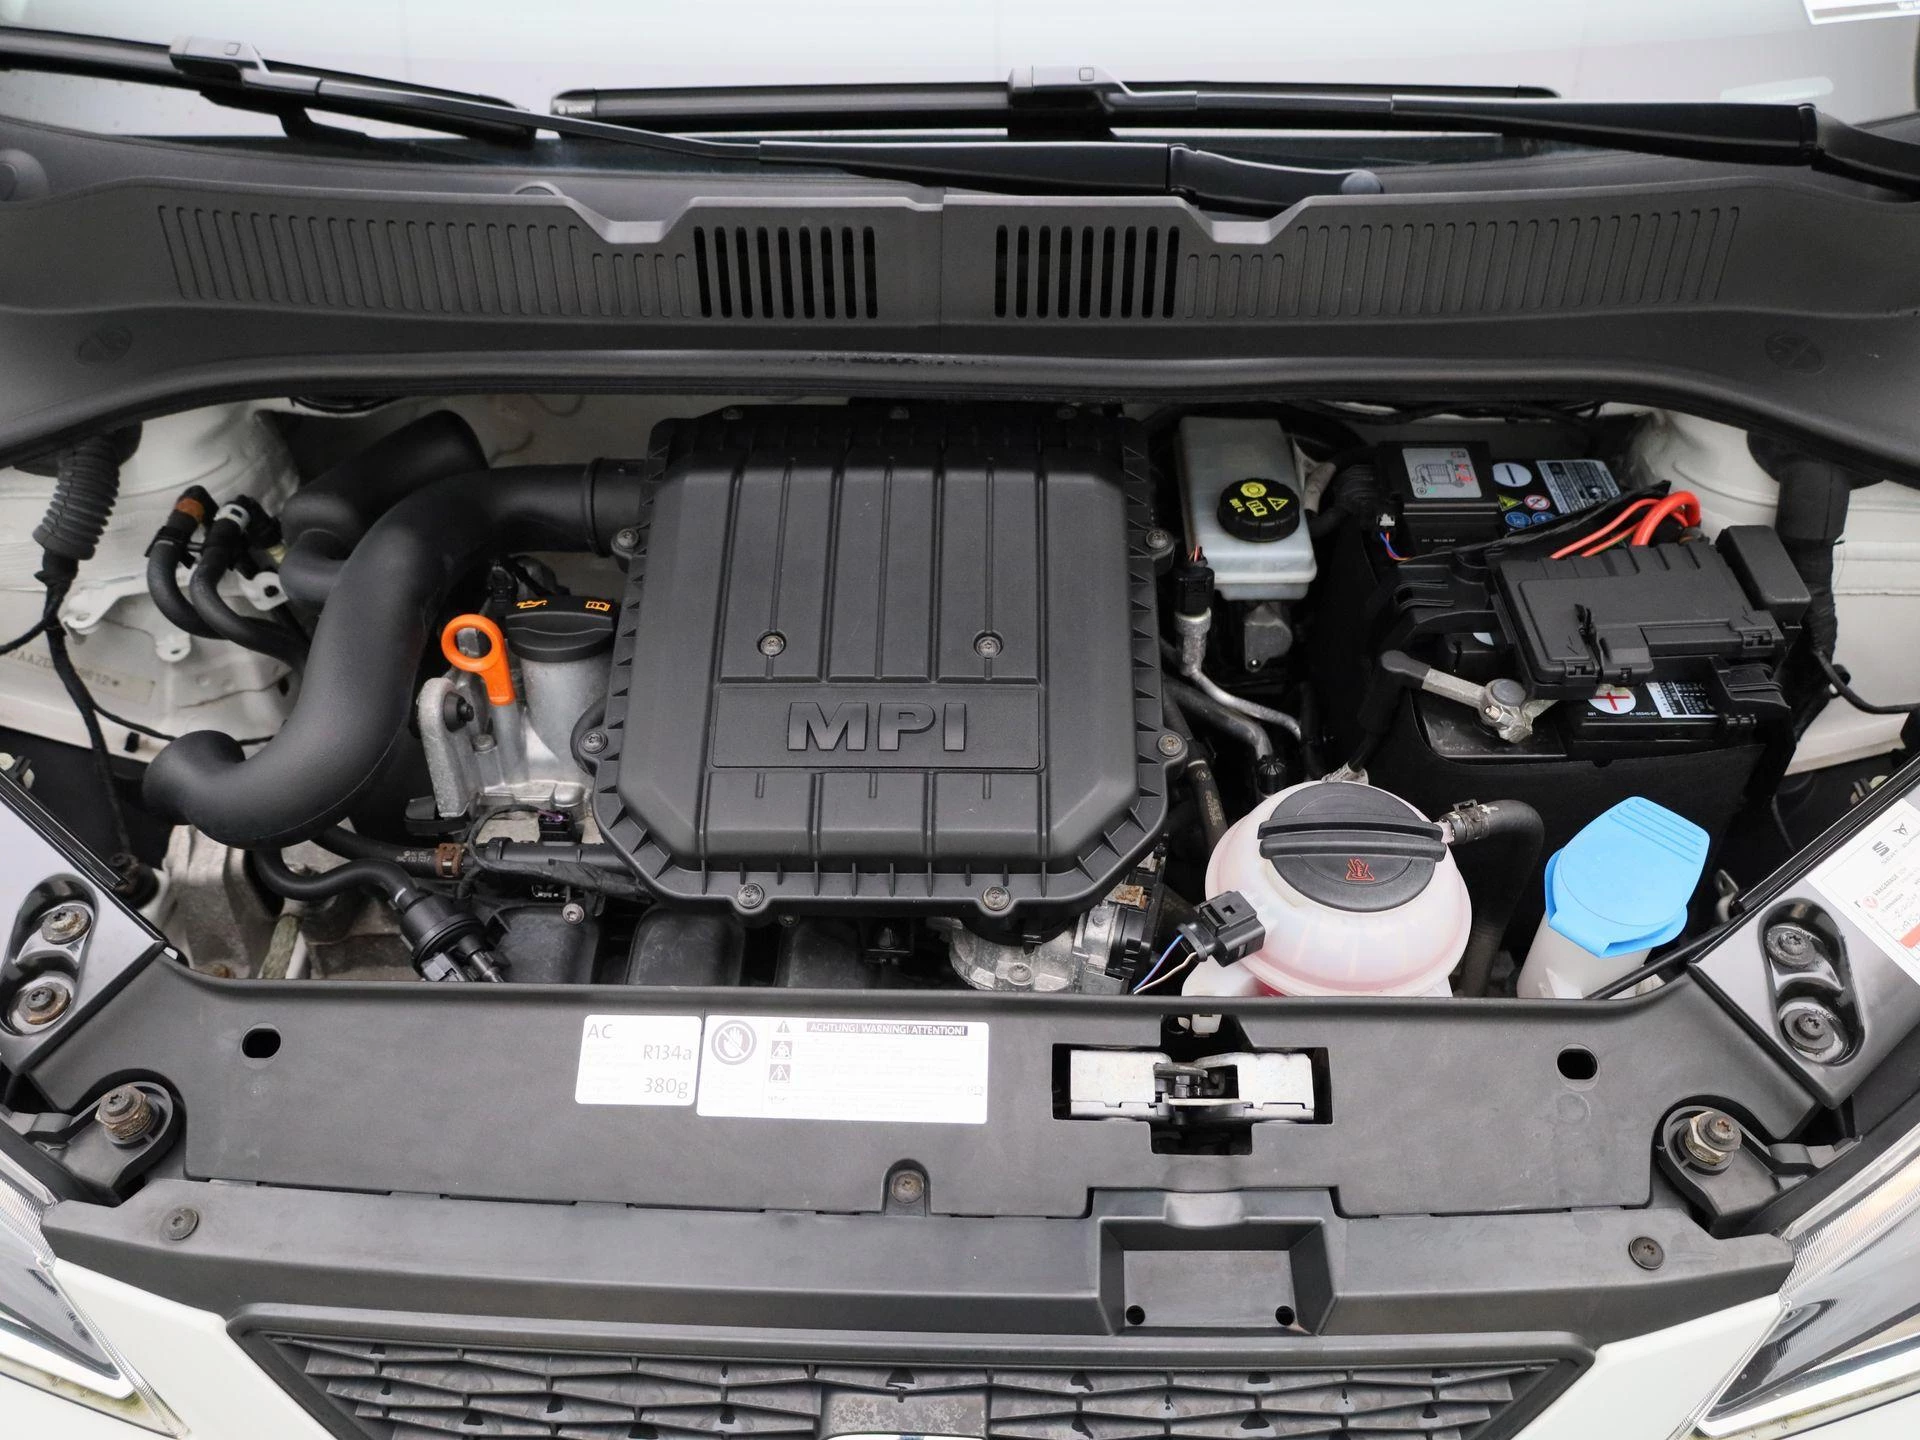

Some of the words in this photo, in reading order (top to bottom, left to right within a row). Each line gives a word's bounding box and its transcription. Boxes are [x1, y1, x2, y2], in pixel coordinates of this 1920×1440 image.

[787, 702, 967, 751] MPI
[587, 1023, 613, 1039] AC
[810, 1022, 859, 1033] ACHTUNG!
[862, 1024, 910, 1034] WARNING!
[911, 1025, 965, 1036] ATTENTION!
[643, 1044, 692, 1061] R134a
[643, 1077, 689, 1099] 380g
